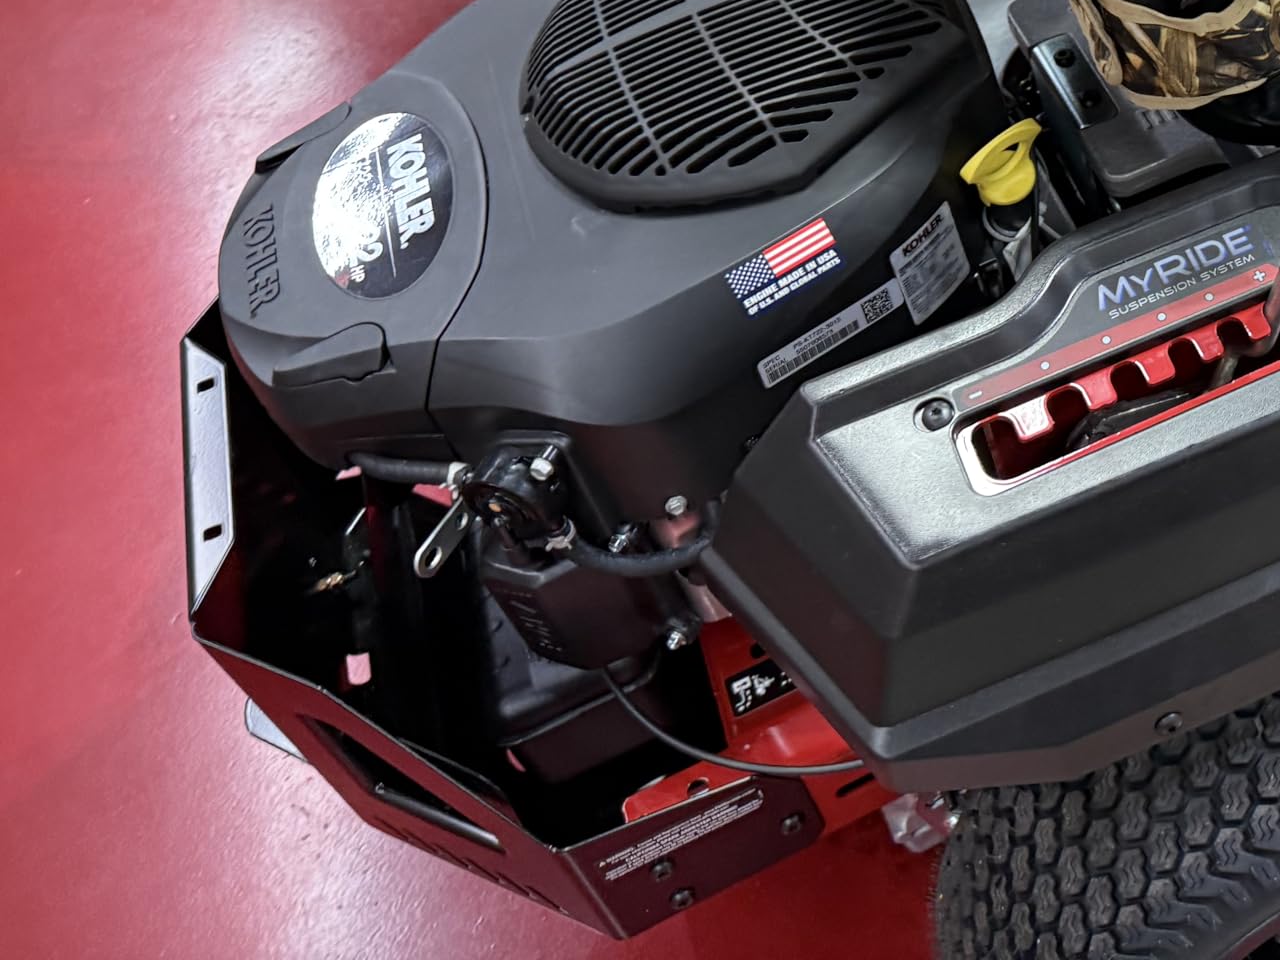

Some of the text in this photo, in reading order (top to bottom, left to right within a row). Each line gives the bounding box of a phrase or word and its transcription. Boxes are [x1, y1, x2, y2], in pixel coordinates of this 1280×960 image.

[742, 248, 837, 307] ENGINE MADE IN USA
[773, 286, 790, 300] AND
[789, 270, 817, 290] GLOBAL
[816, 256, 841, 274] PARTS
[1109, 254, 1256, 319] SUSPENSION SYSTEM
